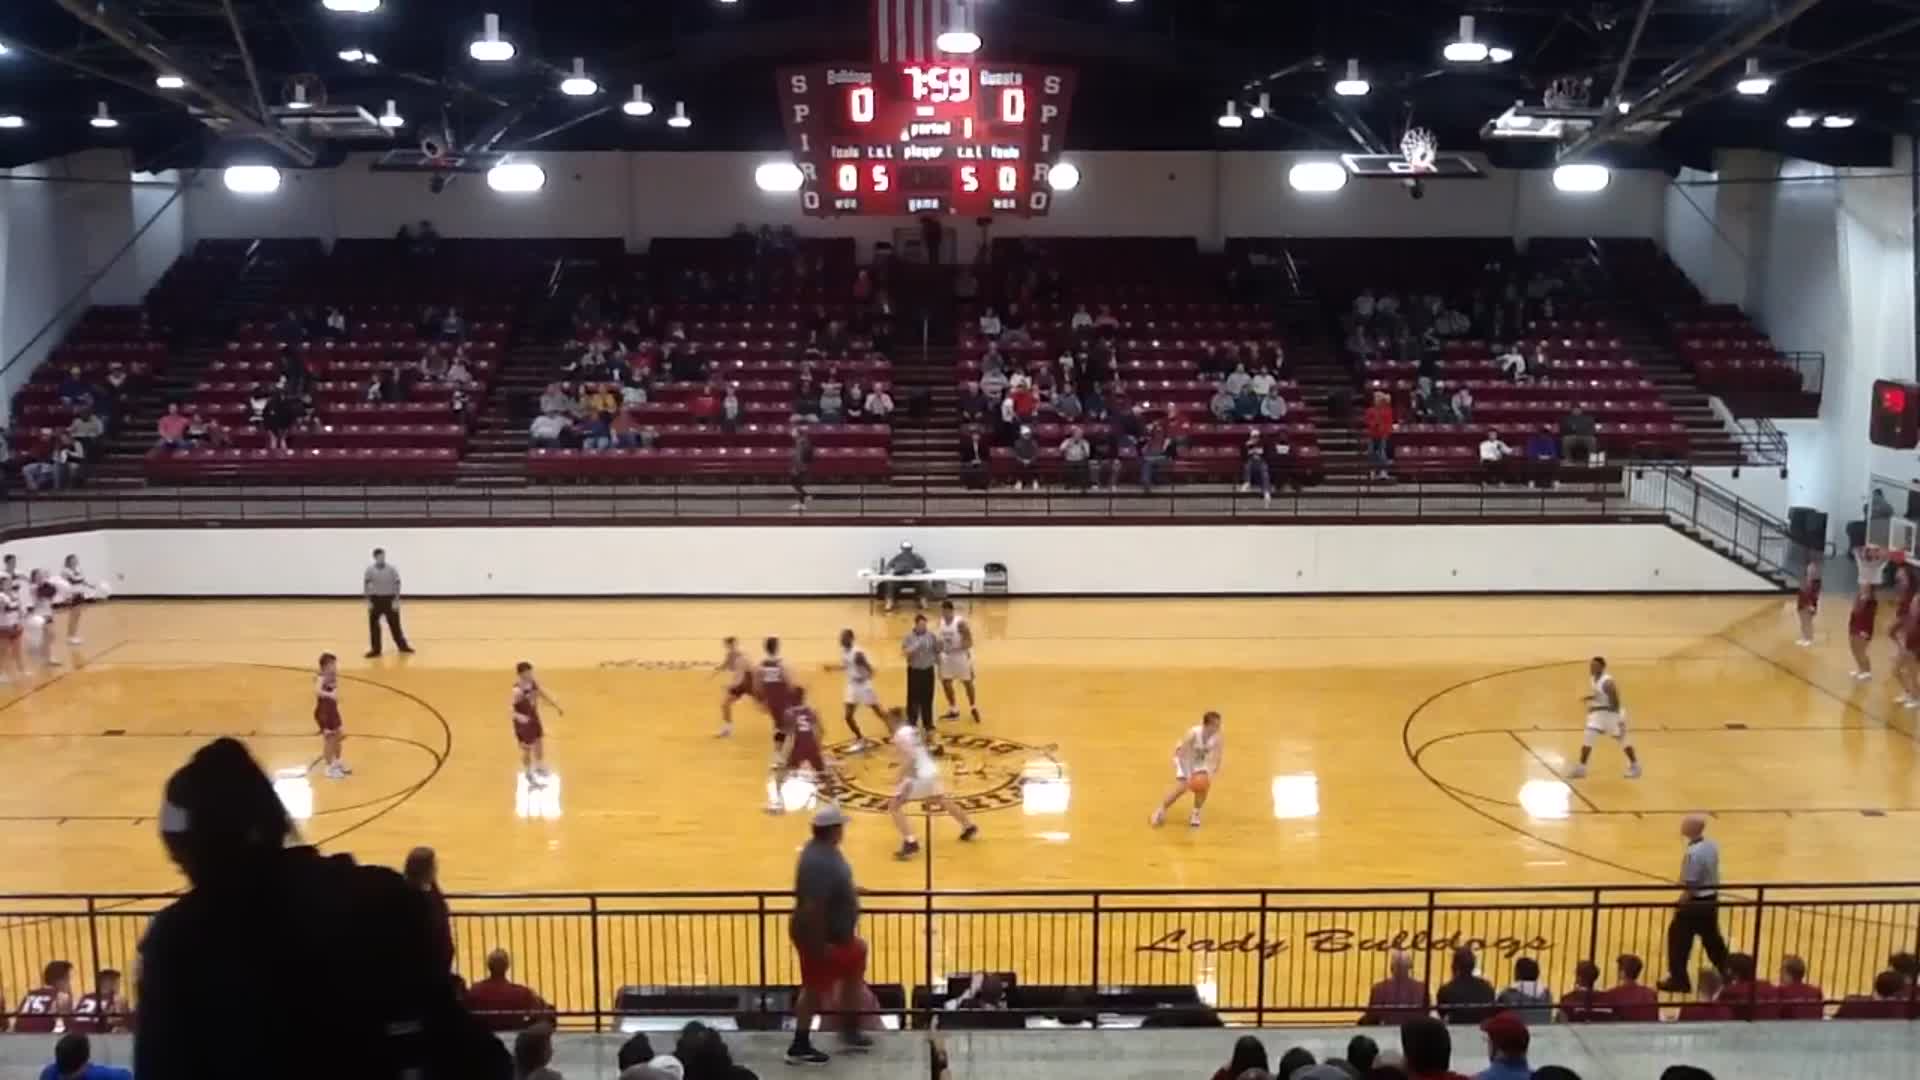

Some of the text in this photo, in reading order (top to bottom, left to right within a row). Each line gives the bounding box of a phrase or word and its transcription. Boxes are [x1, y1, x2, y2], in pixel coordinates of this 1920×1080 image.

[904, 66, 972, 102] 7:59
[851, 87, 874, 122] 0
[1002, 88, 1025, 123] 0
[1029, 76, 1061, 209] SPIRO
[839, 164, 858, 192] 0
[999, 166, 1017, 192] 0
[1134, 928, 1556, 959] Lady Bulldogs
